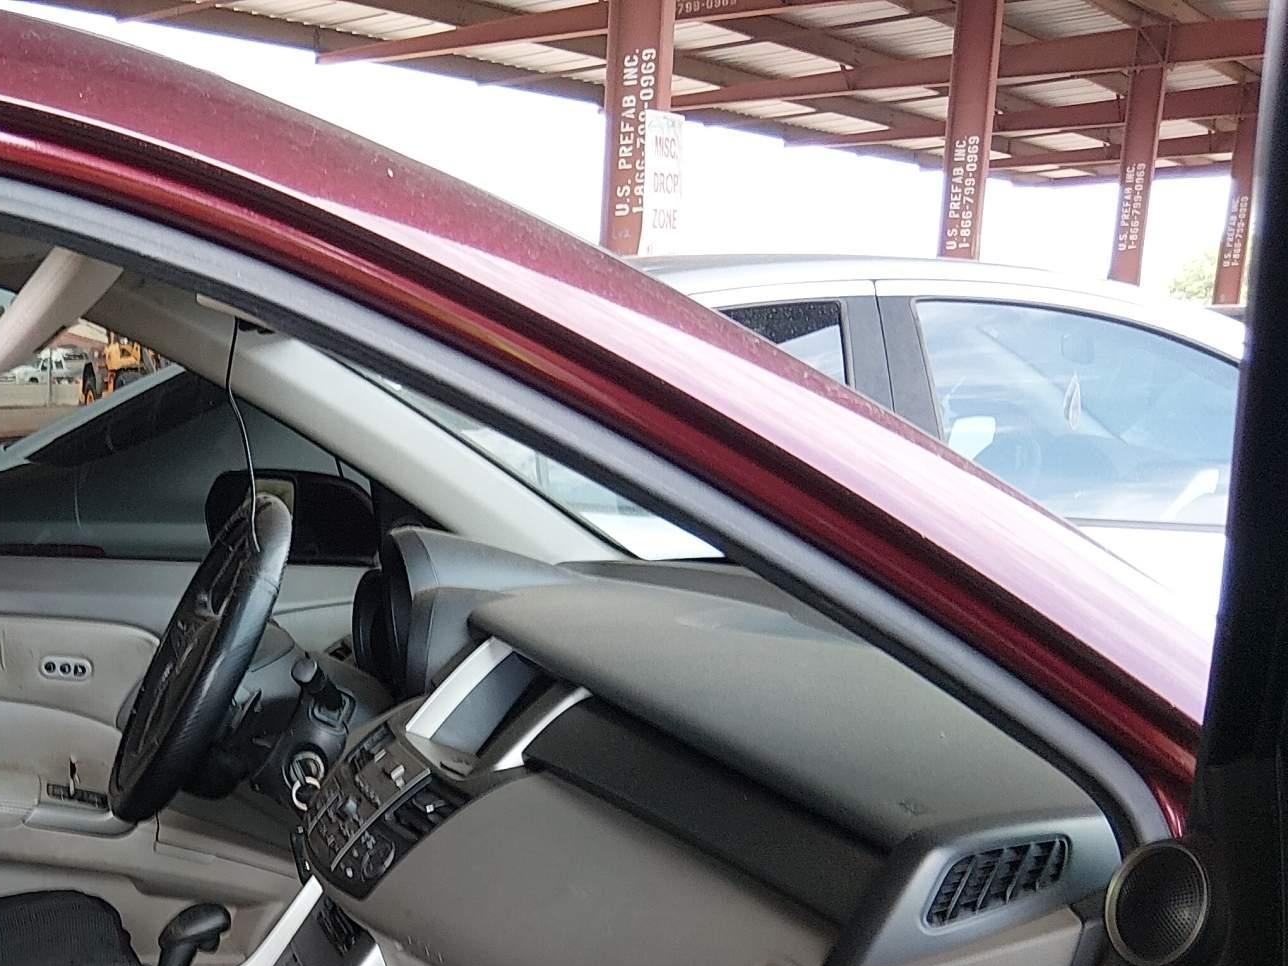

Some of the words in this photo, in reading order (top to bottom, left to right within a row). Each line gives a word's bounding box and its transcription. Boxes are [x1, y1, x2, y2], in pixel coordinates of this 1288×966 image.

[623, 48, 640, 86] INC.
[618, 95, 636, 170] PREFAB
[954, 136, 968, 162] INC.
[615, 179, 632, 217] U.S.
[653, 171, 679, 195] DROP
[948, 167, 965, 218] PREFAB
[958, 135, 980, 249] 1-866-799-0969
[652, 208, 678, 230] ZONE
[1120, 187, 1133, 227] PREFAB
[946, 224, 959, 250] U.S.
